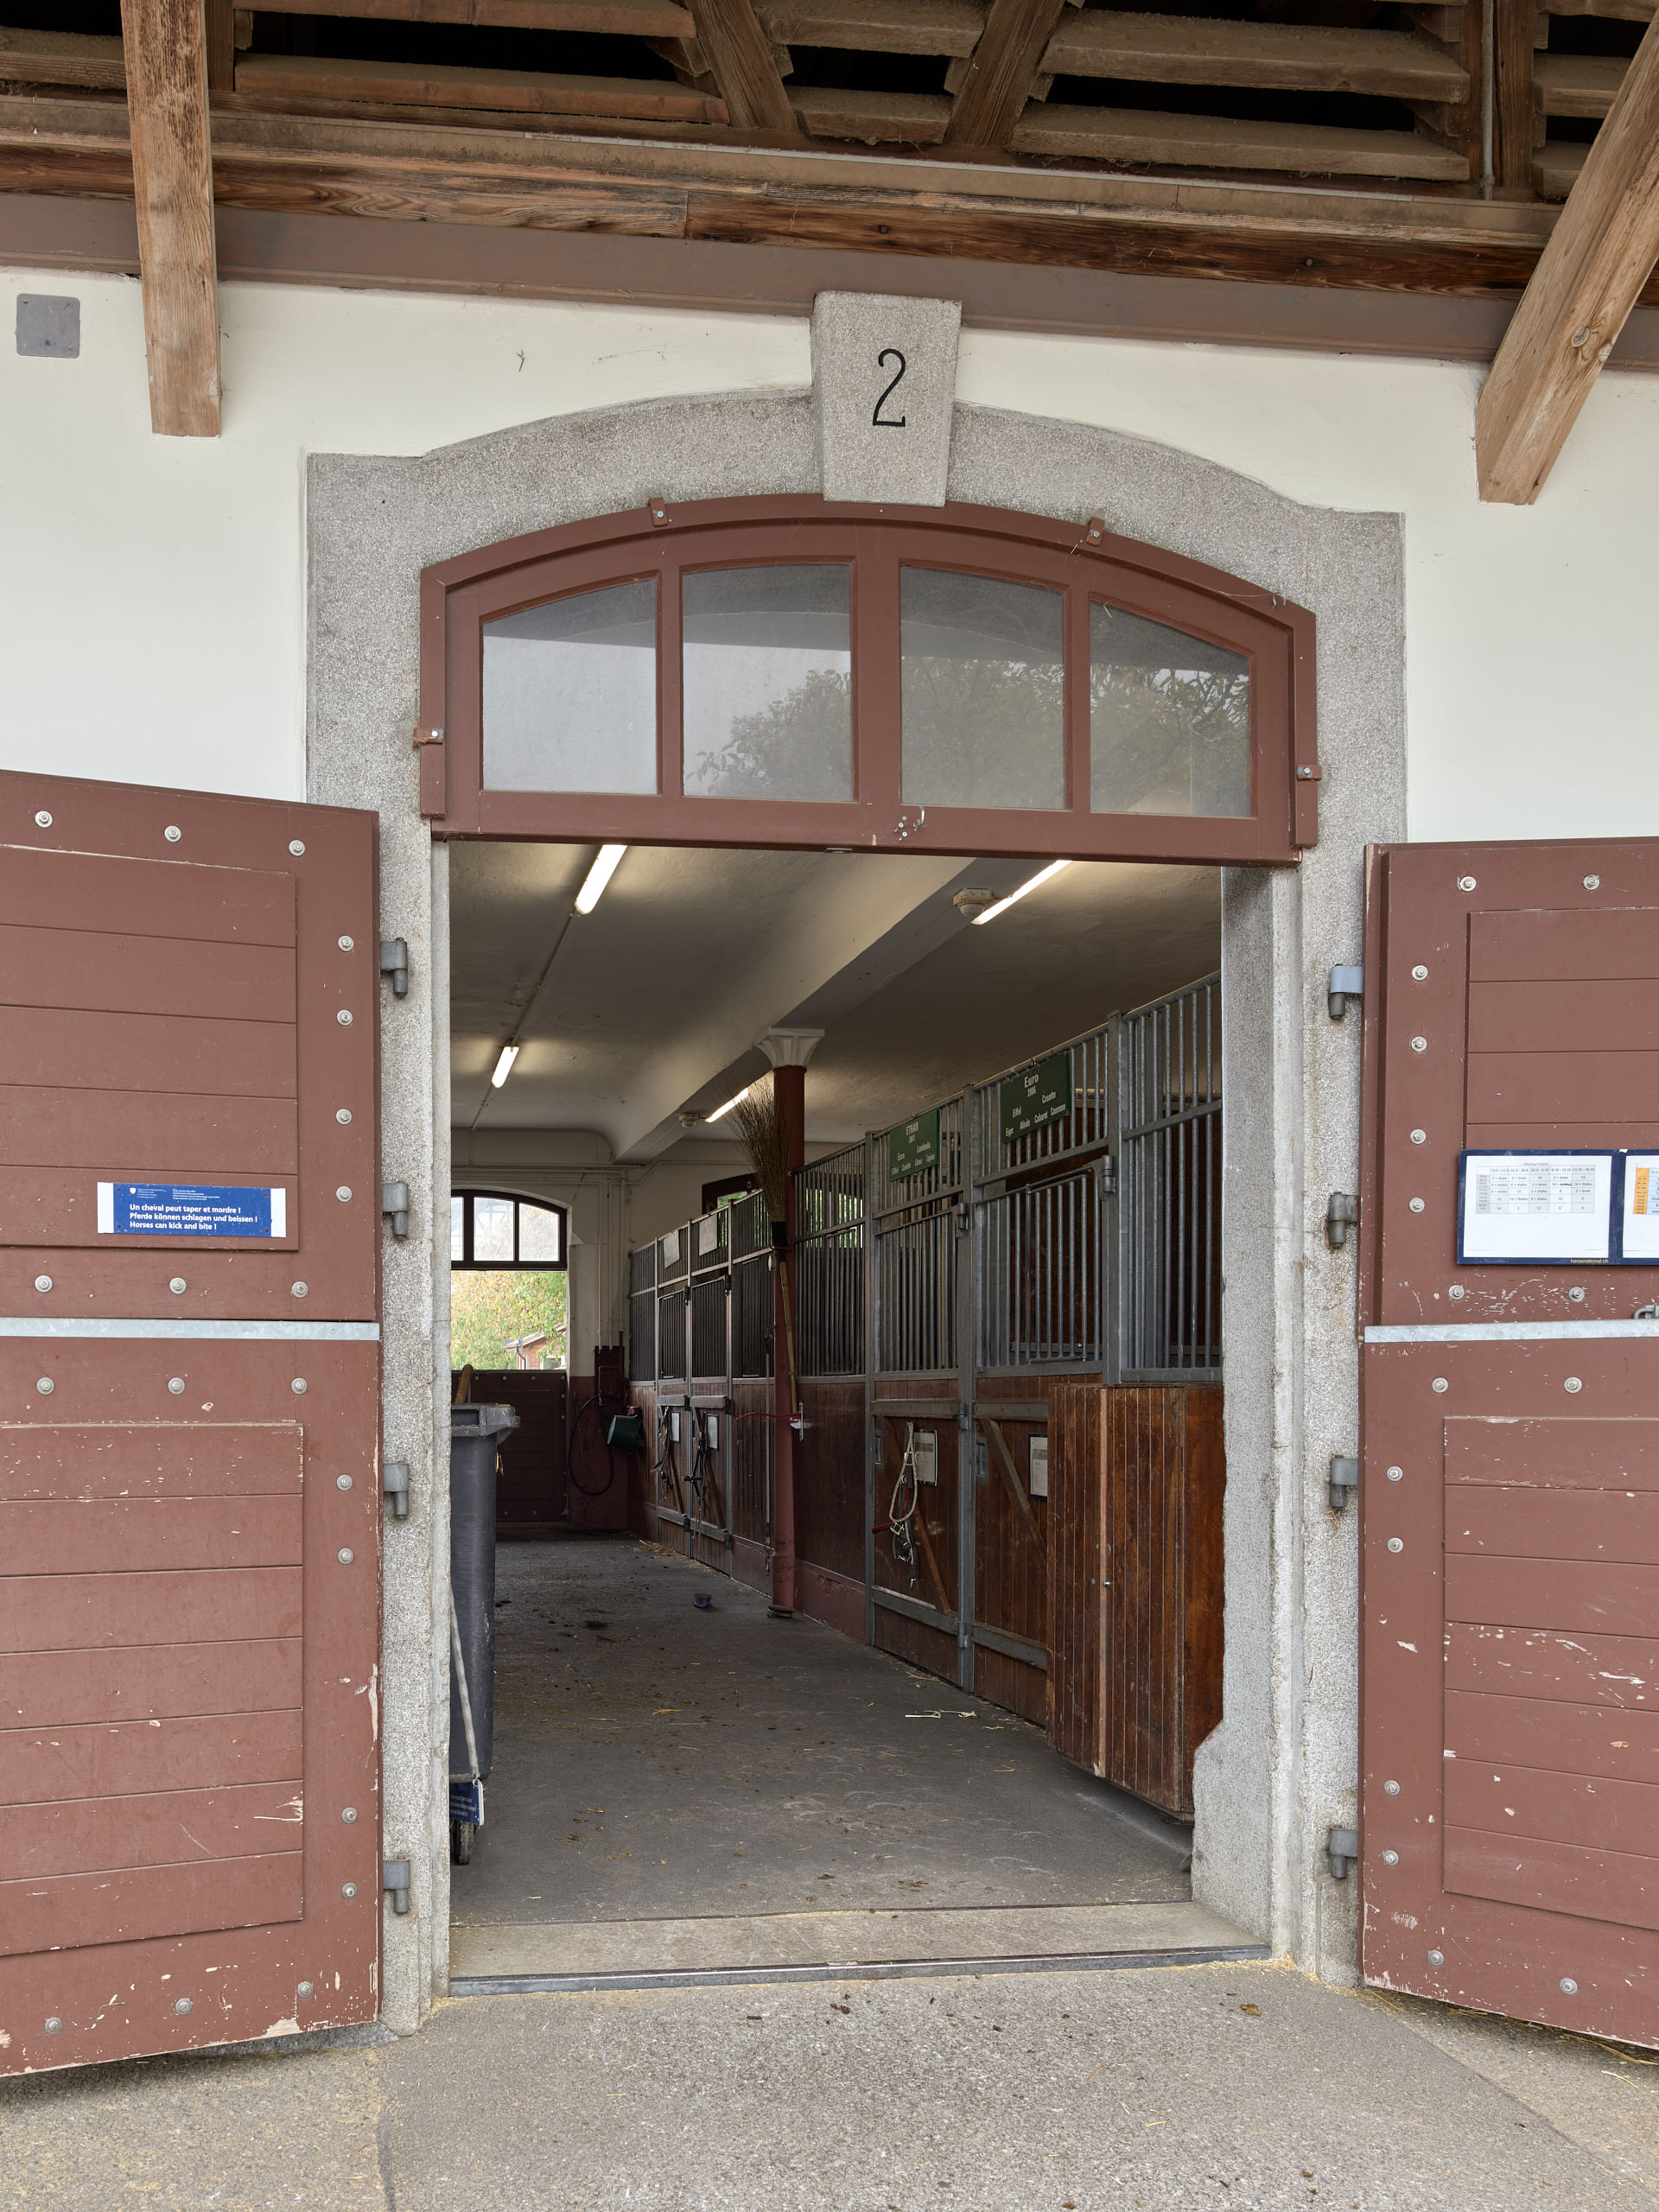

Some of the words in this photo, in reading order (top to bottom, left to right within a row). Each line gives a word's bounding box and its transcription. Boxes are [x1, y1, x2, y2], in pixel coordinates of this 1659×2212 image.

[873, 348, 906, 427] 2
[1024, 1074, 1039, 1089] Euro
[165, 1205, 181, 1213] peut
[154, 1212, 181, 1221] können
